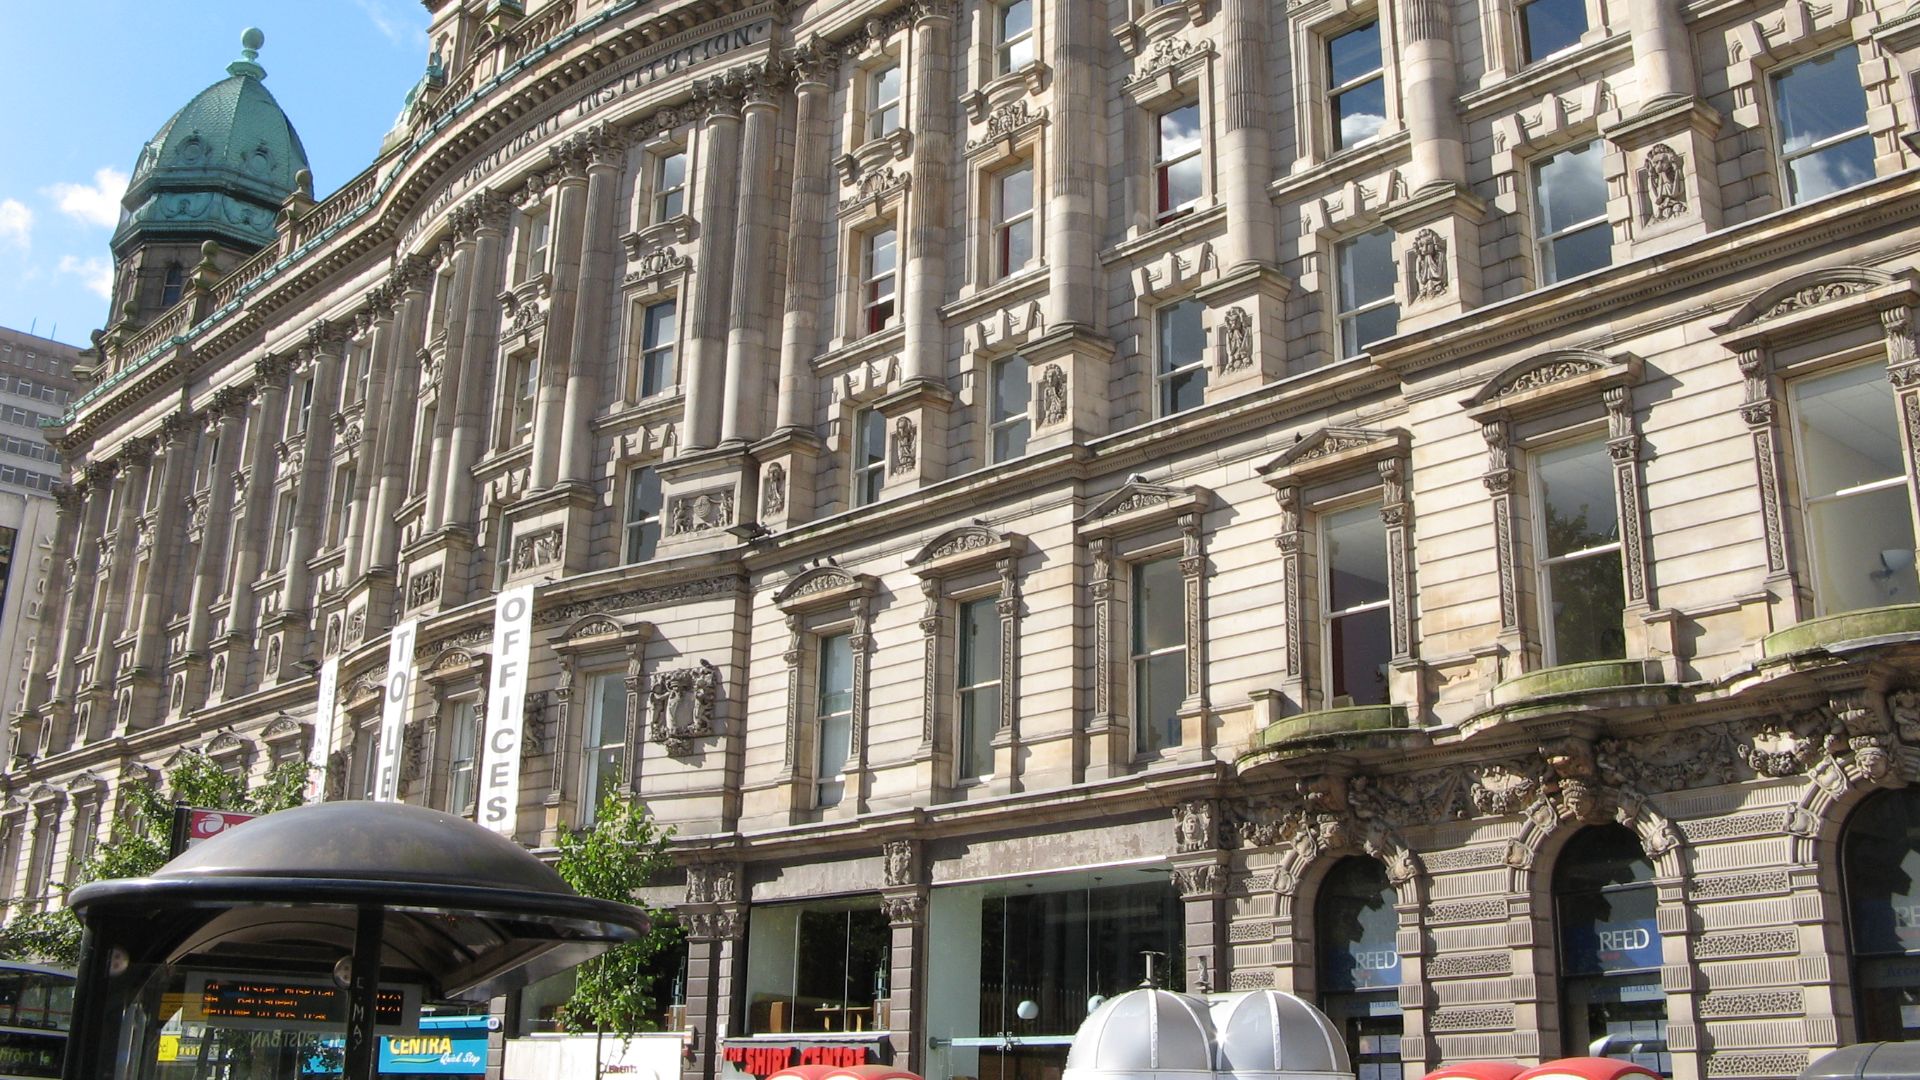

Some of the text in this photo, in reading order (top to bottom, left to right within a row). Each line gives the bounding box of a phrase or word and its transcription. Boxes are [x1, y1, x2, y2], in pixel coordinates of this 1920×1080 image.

[577, 24, 754, 116] INSTITUTION
[390, 630, 410, 703] TO
[486, 596, 526, 823] OFFICES
[1600, 928, 1650, 951] REED
[1355, 950, 1398, 970] REED
[389, 1037, 454, 1055] CENTRA
[439, 1052, 481, 1067] Quick Stop
[724, 1046, 866, 1076] THE SHIRT CENTRE
